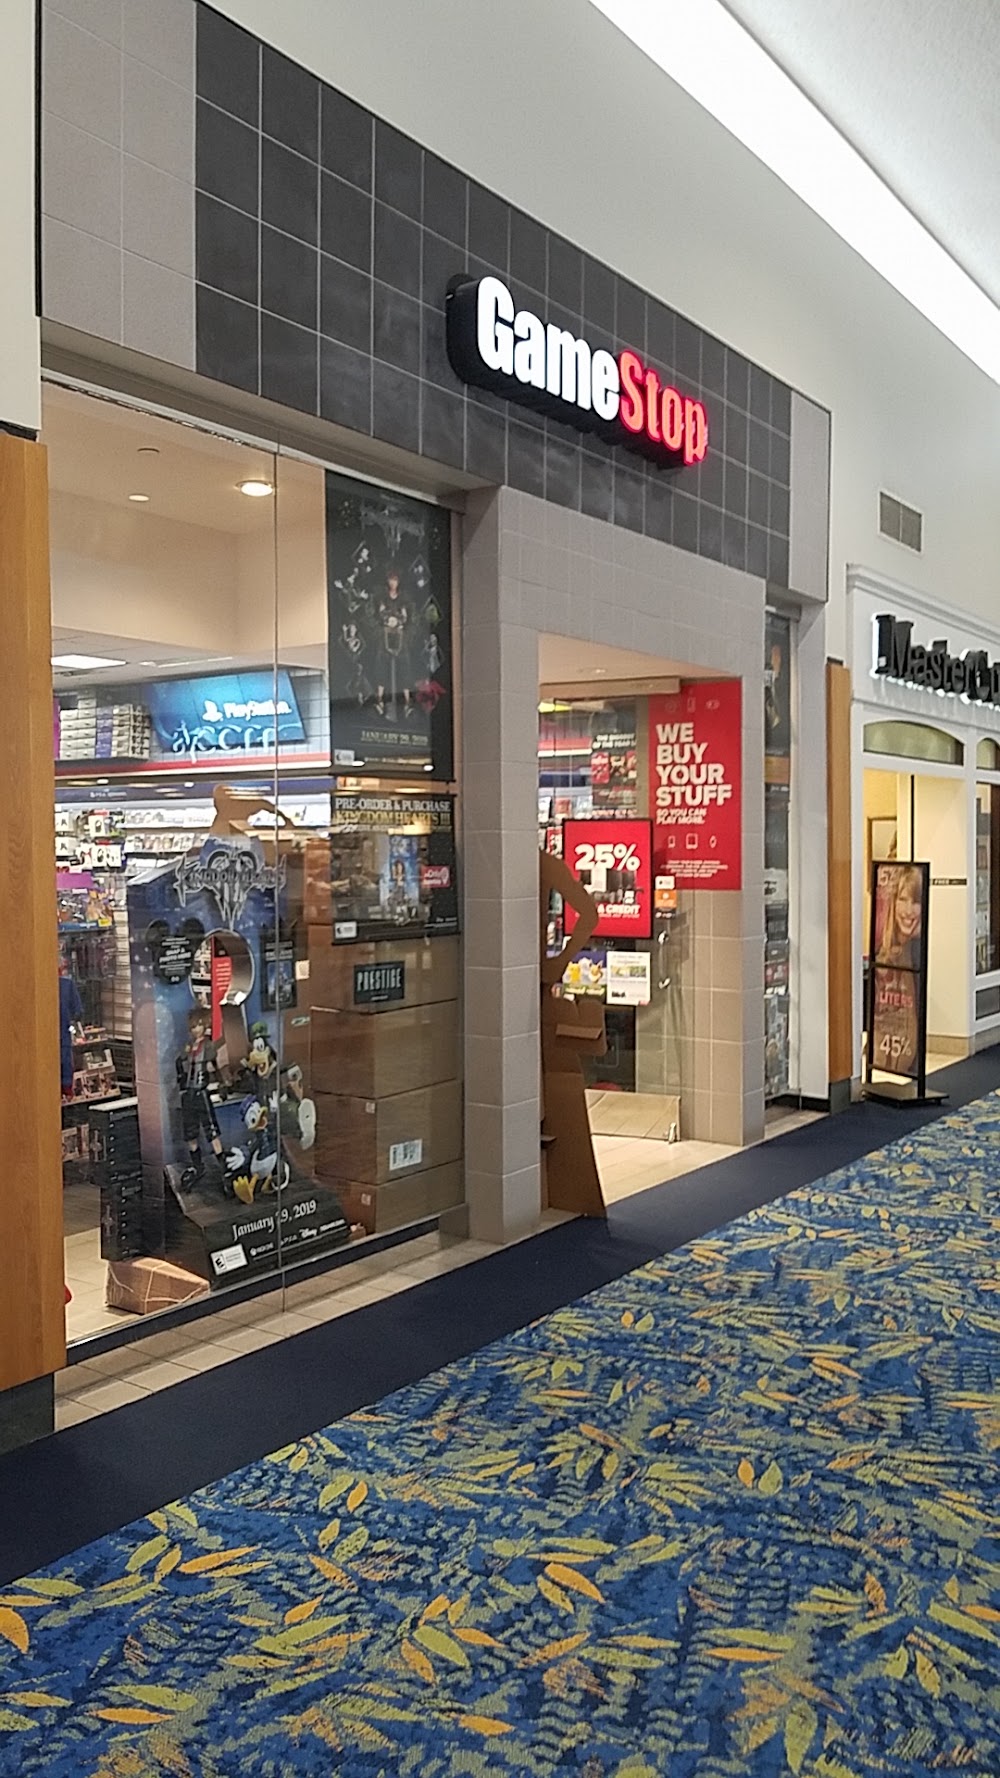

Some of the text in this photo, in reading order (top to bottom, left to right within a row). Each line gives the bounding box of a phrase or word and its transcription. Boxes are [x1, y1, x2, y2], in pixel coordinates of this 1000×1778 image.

[477, 276, 708, 465] GameStop
[656, 722, 694, 744] WE
[656, 743, 708, 765] BUY
[656, 763, 725, 785] YOUR
[335, 798, 392, 811] PRE-ORDER
[402, 801, 451, 812] PURCHASE
[656, 784, 732, 806] STUFF
[336, 811, 393, 825] KINGDOM
[440, 814, 451, 826] III
[669, 808, 687, 818] YOU
[575, 843, 641, 871] 25%
[605, 904, 641, 914] CREDIT
[356, 967, 401, 991] PRESTIGE
[880, 1034, 912, 1058] 45%
[232, 1215, 275, 1241] January
[293, 1199, 317, 1218] 2019
